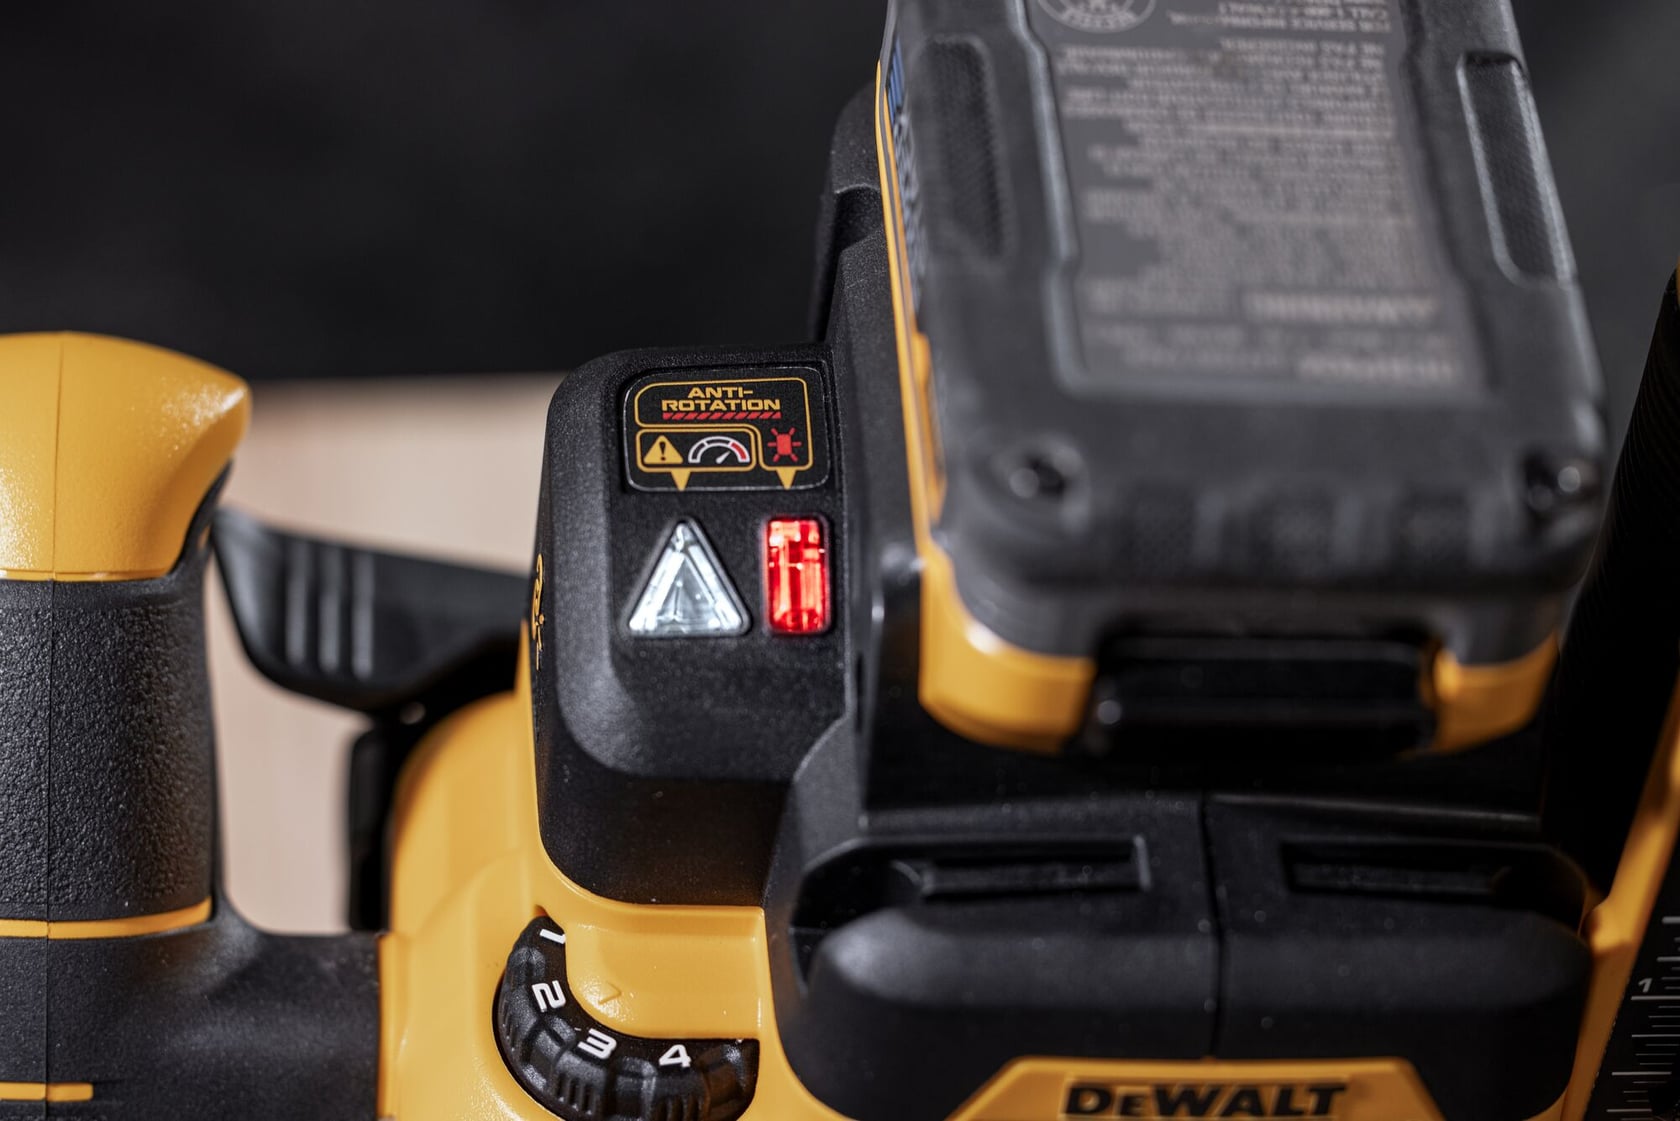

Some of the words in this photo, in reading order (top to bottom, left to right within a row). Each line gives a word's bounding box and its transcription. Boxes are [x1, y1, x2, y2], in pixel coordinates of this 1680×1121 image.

[687, 386, 754, 399] ANTI-
[661, 399, 781, 412] ROTATION
[539, 928, 566, 945] 1
[1638, 977, 1653, 993] 1
[531, 980, 567, 1013] 2
[577, 1028, 617, 1060] 3
[658, 1044, 693, 1069] 4
